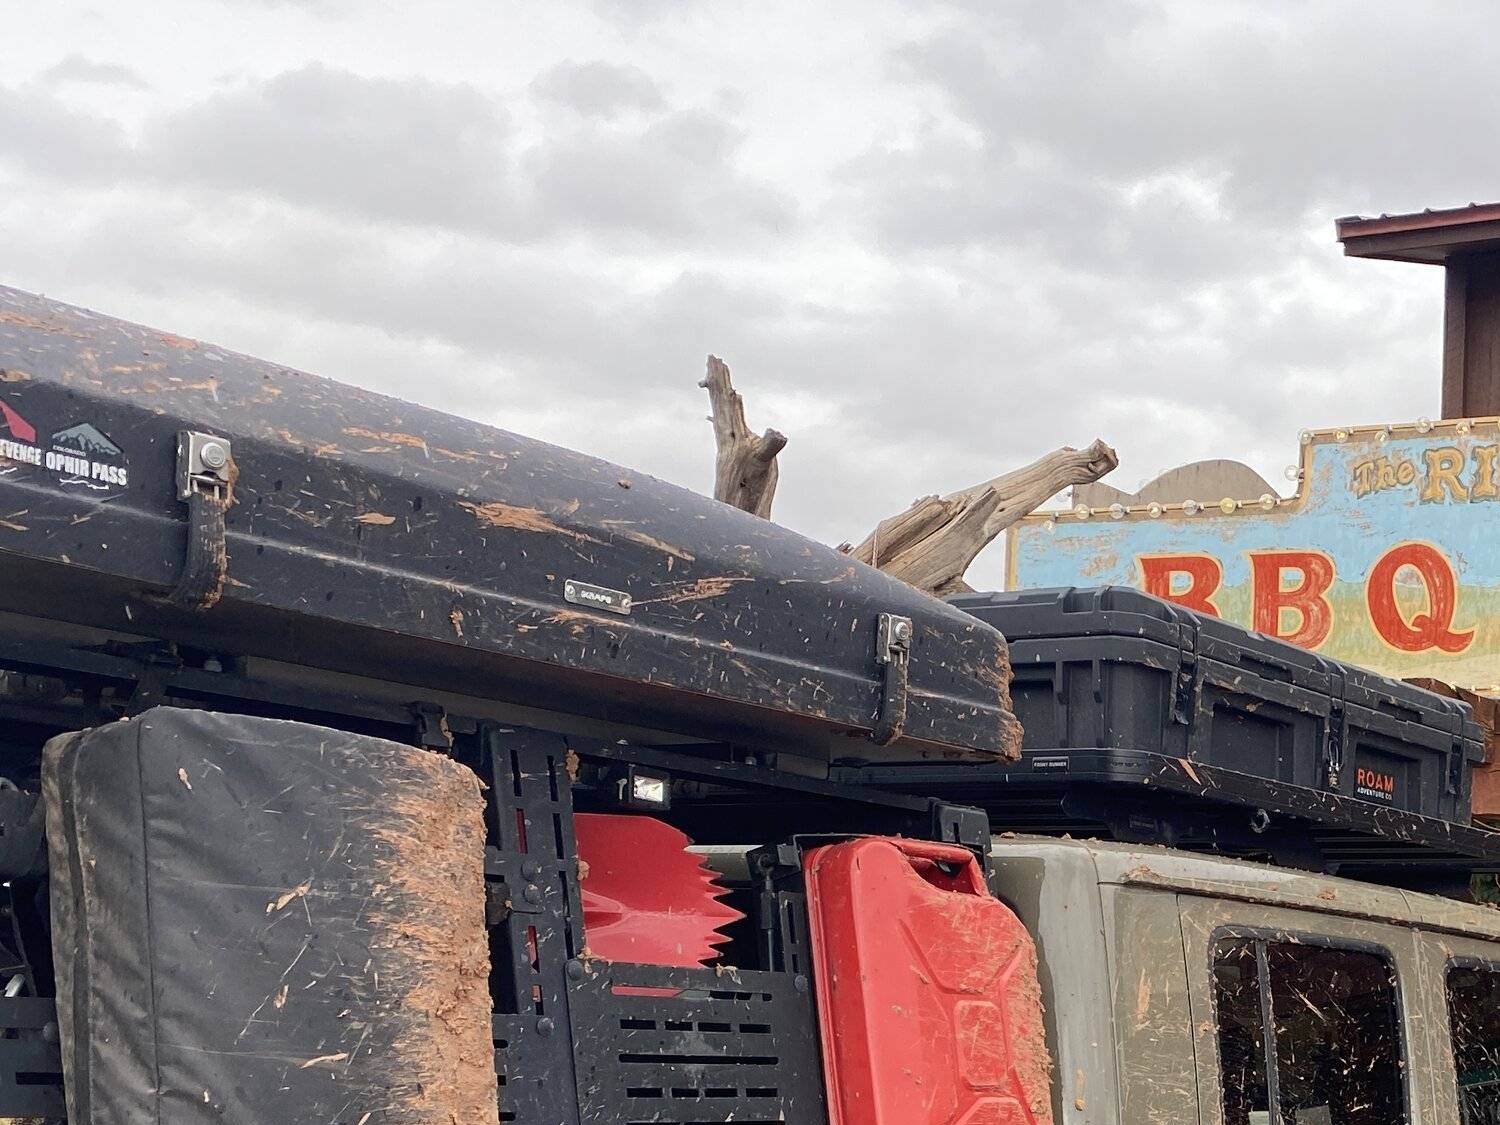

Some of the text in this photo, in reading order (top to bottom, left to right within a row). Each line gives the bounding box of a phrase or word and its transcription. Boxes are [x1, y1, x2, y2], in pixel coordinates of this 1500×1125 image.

[45, 451, 127, 486] OPHIR PASS
[1353, 456, 1416, 499] The
[1357, 768, 1393, 792] ROAM
